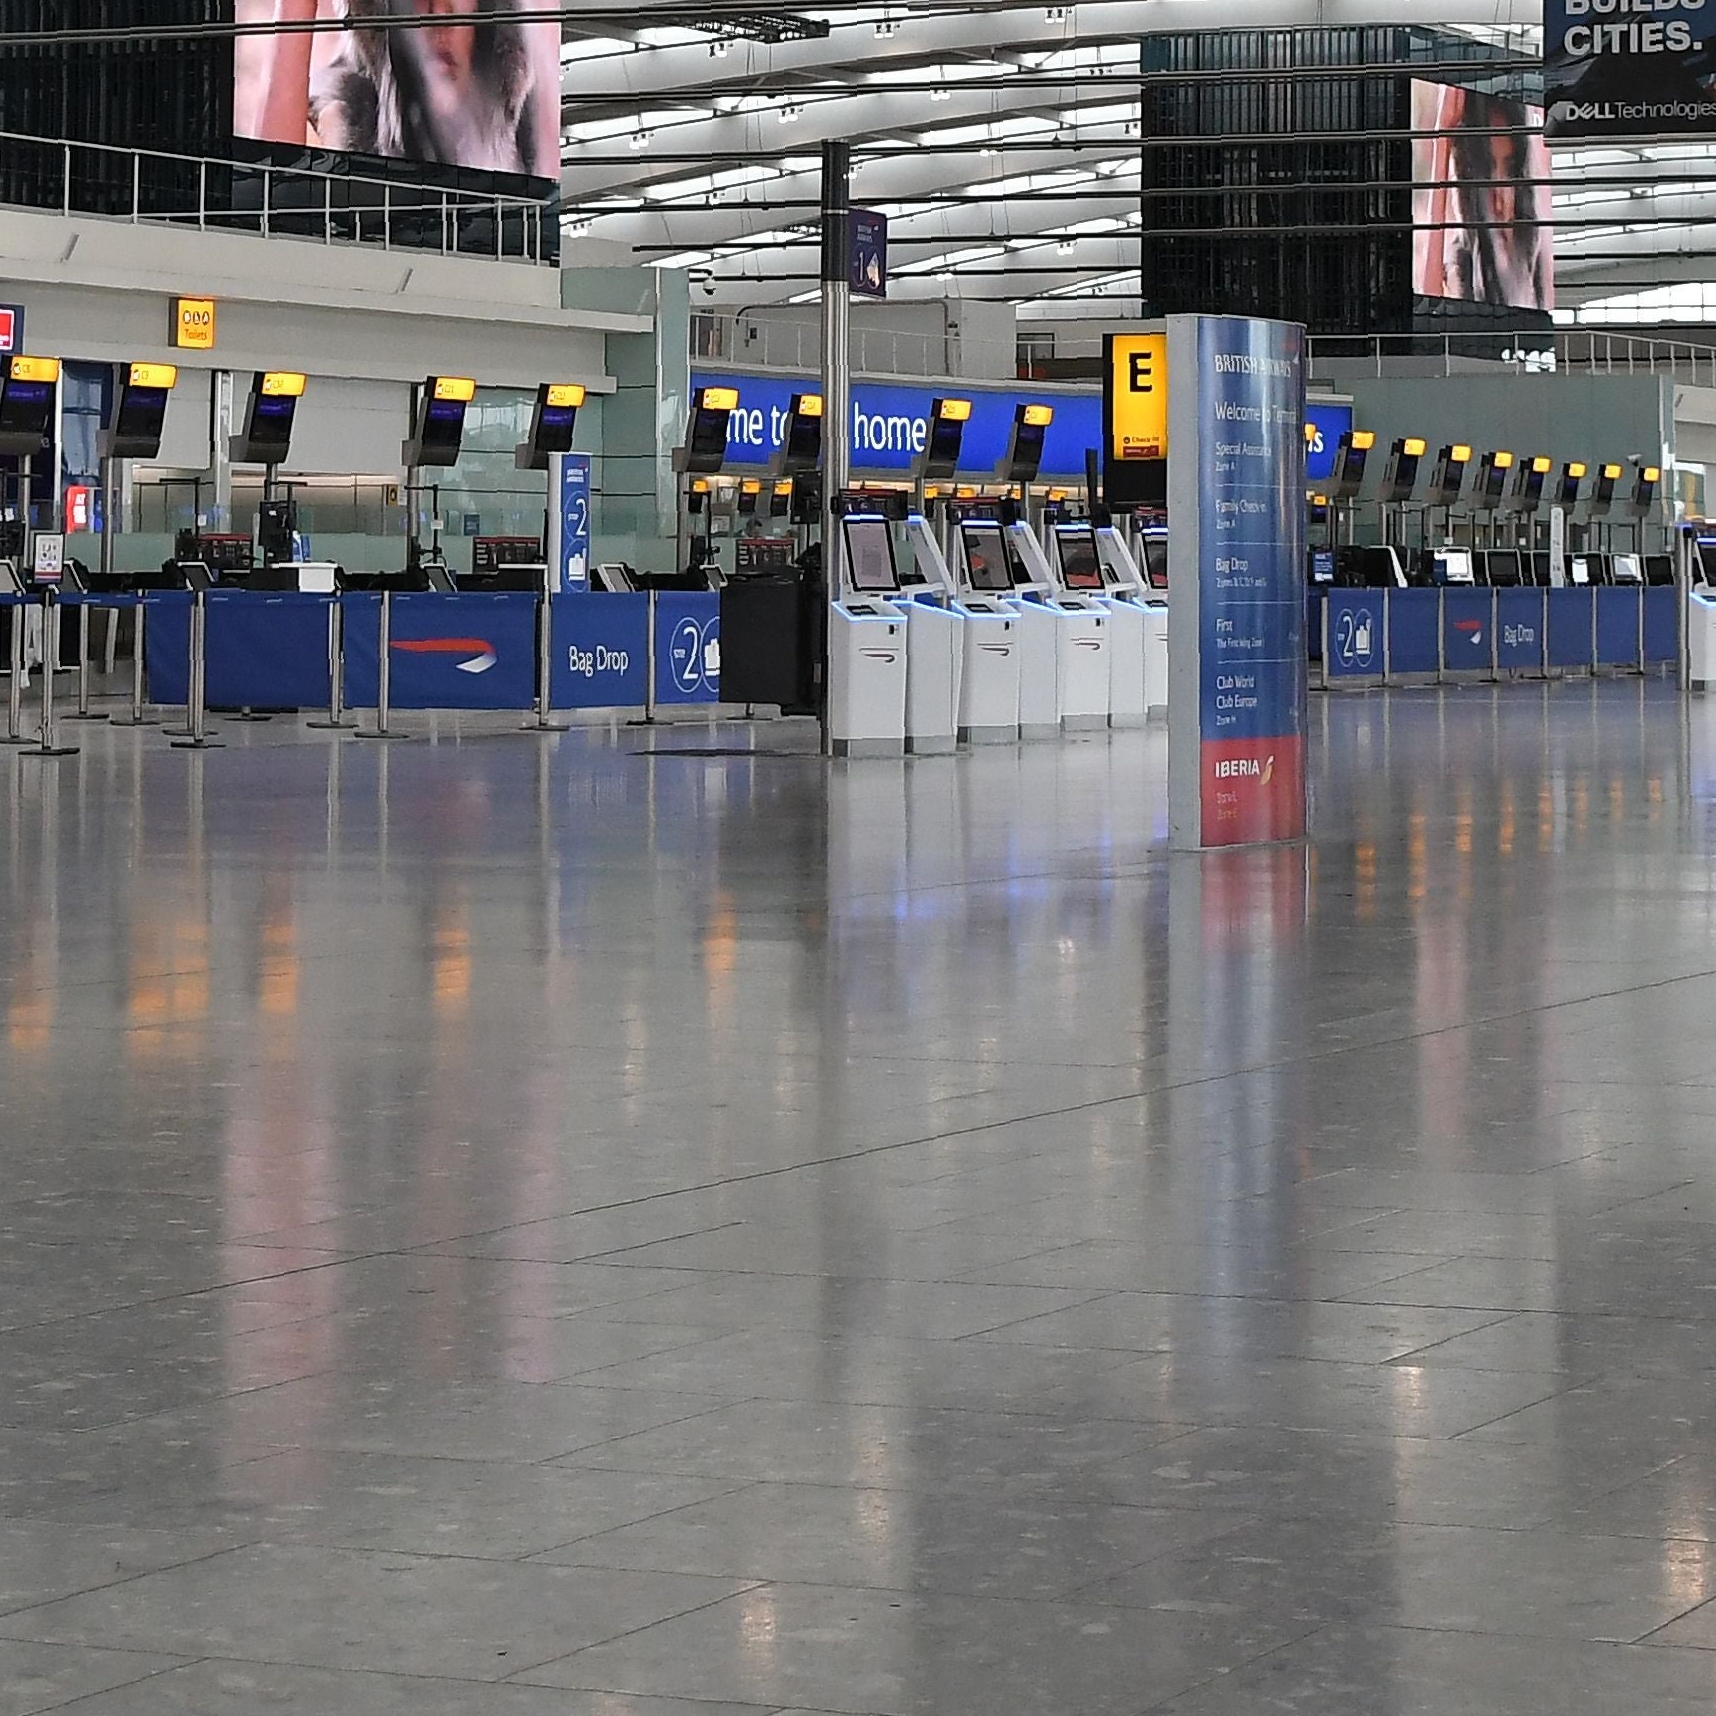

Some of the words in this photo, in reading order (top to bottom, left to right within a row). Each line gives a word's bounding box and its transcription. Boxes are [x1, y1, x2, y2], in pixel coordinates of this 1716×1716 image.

[1564, 21, 1703, 56] CITIES.
[184, 328, 208, 341] Toilets
[1129, 351, 1153, 392] E
[1215, 354, 1257, 374] BRITISH
[1215, 401, 1261, 422] Welcome
[854, 401, 927, 453] home
[576, 498, 587, 536] 2
[1215, 558, 1231, 573] Bag
[1232, 558, 1249, 573] Drop
[1504, 624, 1517, 647] Bag
[1518, 624, 1534, 646] Drop
[568, 645, 594, 677] Bag
[596, 645, 629, 676] Drop
[682, 626, 699, 680] 2
[1216, 675, 1235, 690] Club
[1235, 675, 1255, 688] World
[1216, 695, 1235, 709] Club
[1235, 695, 1258, 708] Europe
[1215, 759, 1261, 778] IBERIA
